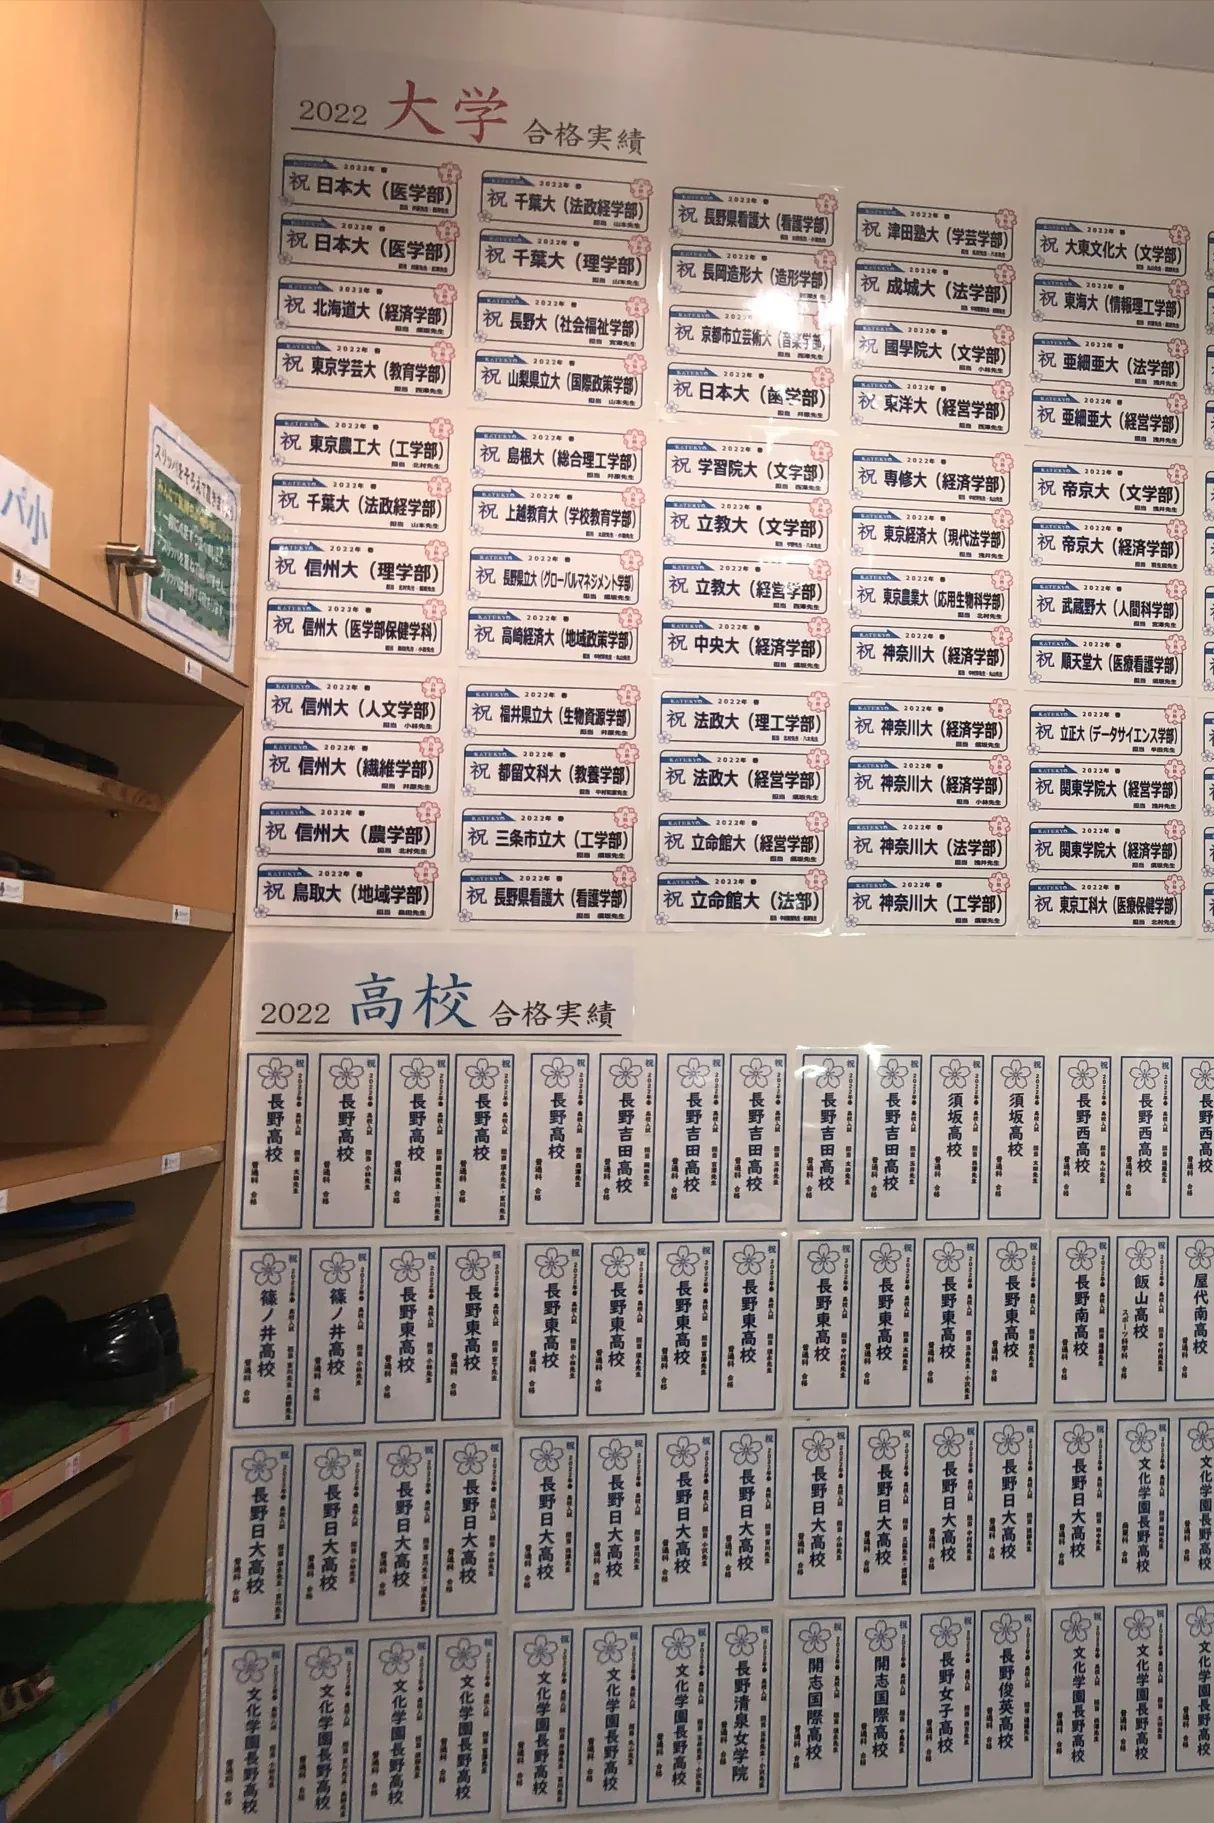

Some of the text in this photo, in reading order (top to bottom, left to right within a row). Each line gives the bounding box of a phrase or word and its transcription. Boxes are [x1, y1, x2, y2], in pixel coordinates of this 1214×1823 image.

[300, 80, 646, 156] 2022 大学 合格実績
[317, 176, 451, 205] 日本大（医学部）
[515, 192, 643, 220] 千葉大（法政経学部）
[704, 209, 828, 235] 長野県看護大（看護学部）
[888, 223, 1007, 249] 津田塾大（学芸学部）
[513, 249, 641, 275] 千葉大（理学部）
[1066, 239, 1181, 265] 大東文化大（文学部）
[703, 264, 827, 289] 長岡造形大（造形学部）
[887, 277, 1007, 304] 成城大（法学部）
[313, 298, 447, 326] 北海道大（経済学部）
[1064, 293, 1181, 319] 東海大（情報理工学部）
[510, 312, 639, 339] 長野大（社会福祉学部）
[885, 339, 1005, 364] 國學院大（文学部）
[312, 357, 445, 385] 東京学芸大（教育学部）
[1064, 353, 1180, 379] 亜細亜大（法学部）
[508, 371, 638, 396] 山梨県立大（国際政策学部）
[885, 394, 1005, 420] 東洋大（経営学部）
[1062, 408, 1179, 433] 亜細亜大（経営学部）
[309, 434, 444, 461] 東京農工大（工学部）
[508, 446, 637, 472] 島根大（総合理工学部）
[698, 457, 824, 483] 学習院大（文学部）
[885, 469, 1005, 493] 専修大（経済学部）
[1063, 480, 1179, 506] 帝京大（文学部）
[506, 505, 635, 529] 上越教育大（学校教育学部）
[697, 515, 824, 539] 立教大（文学部）
[884, 527, 1005, 550] 東京経済大（現代法学部）
[1063, 536, 1179, 561] 帝京大（経済学部）
[305, 558, 438, 584] 信州大（理学部）
[1062, 597, 1178, 621] 武蔵野大（人間科学部）
[302, 616, 437, 642] 信州大（医学部保健学科）
[502, 625, 632, 651] 高崎経済大（地域政策学部）
[695, 636, 822, 660] 中央大（経済学部）
[883, 644, 1004, 667] 神奈川大（経済学部）
[1061, 651, 1178, 676] 順天堂大（医療看護学部）
[301, 695, 436, 721] 信州大（人文学部）
[500, 702, 630, 728] 福井県立大（生物資源学部）
[694, 710, 821, 734] 法政大（理工学部）
[298, 756, 434, 781] 信州大（繊維学部）
[499, 762, 630, 786] 都留文科大（教養学部）
[693, 767, 821, 791] 法政大（経営学部）
[1059, 778, 1177, 801] 関東学院大（経営学部）
[295, 821, 431, 846] 信州大（農学部）
[495, 827, 628, 850] 三条市立大（工学部）
[691, 832, 819, 854] 立命館大（経営学部）
[880, 836, 1002, 857] 神奈川大（法学部）
[293, 881, 429, 906] 鳥取大（地域学部）
[879, 891, 1002, 914] 神奈川大（工学部）
[1059, 894, 1177, 916] 東京工科大（医療保健学部）
[261, 972, 616, 1029] 2022 高校 合格実績
[266, 1093, 284, 1162] 長野高校
[337, 1093, 356, 1162] 長野高校
[947, 1093, 964, 1158] 須坂高校
[1075, 1093, 1091, 1174] 長野西高校
[616, 1091, 634, 1194] 長野吉田高校
[683, 1091, 701, 1193] 長野吉田高校
[1073, 1275, 1090, 1358] 長野南高校
[1133, 1274, 1150, 1339] 飯山高校
[1193, 1273, 1208, 1354] 屋代南高校
[397, 1286, 418, 1374] 長野東高校
[814, 1277, 832, 1363] 長野東高校
[258, 1289, 279, 1378] 篠ノ井高校
[940, 1461, 958, 1562] 長野日大高校
[1199, 1455, 1212, 1572] 文化学園長野高校
[247, 1487, 269, 1595] 長野日大高校
[806, 1657, 824, 1761] 開志国際高校
[938, 1651, 955, 1755] 長野女子高校
[997, 1647, 1015, 1750] 長野俊英高校
[1135, 1644, 1149, 1761] 文化学園長野高校
[732, 1661, 751, 1783] 長野清泉女学院
